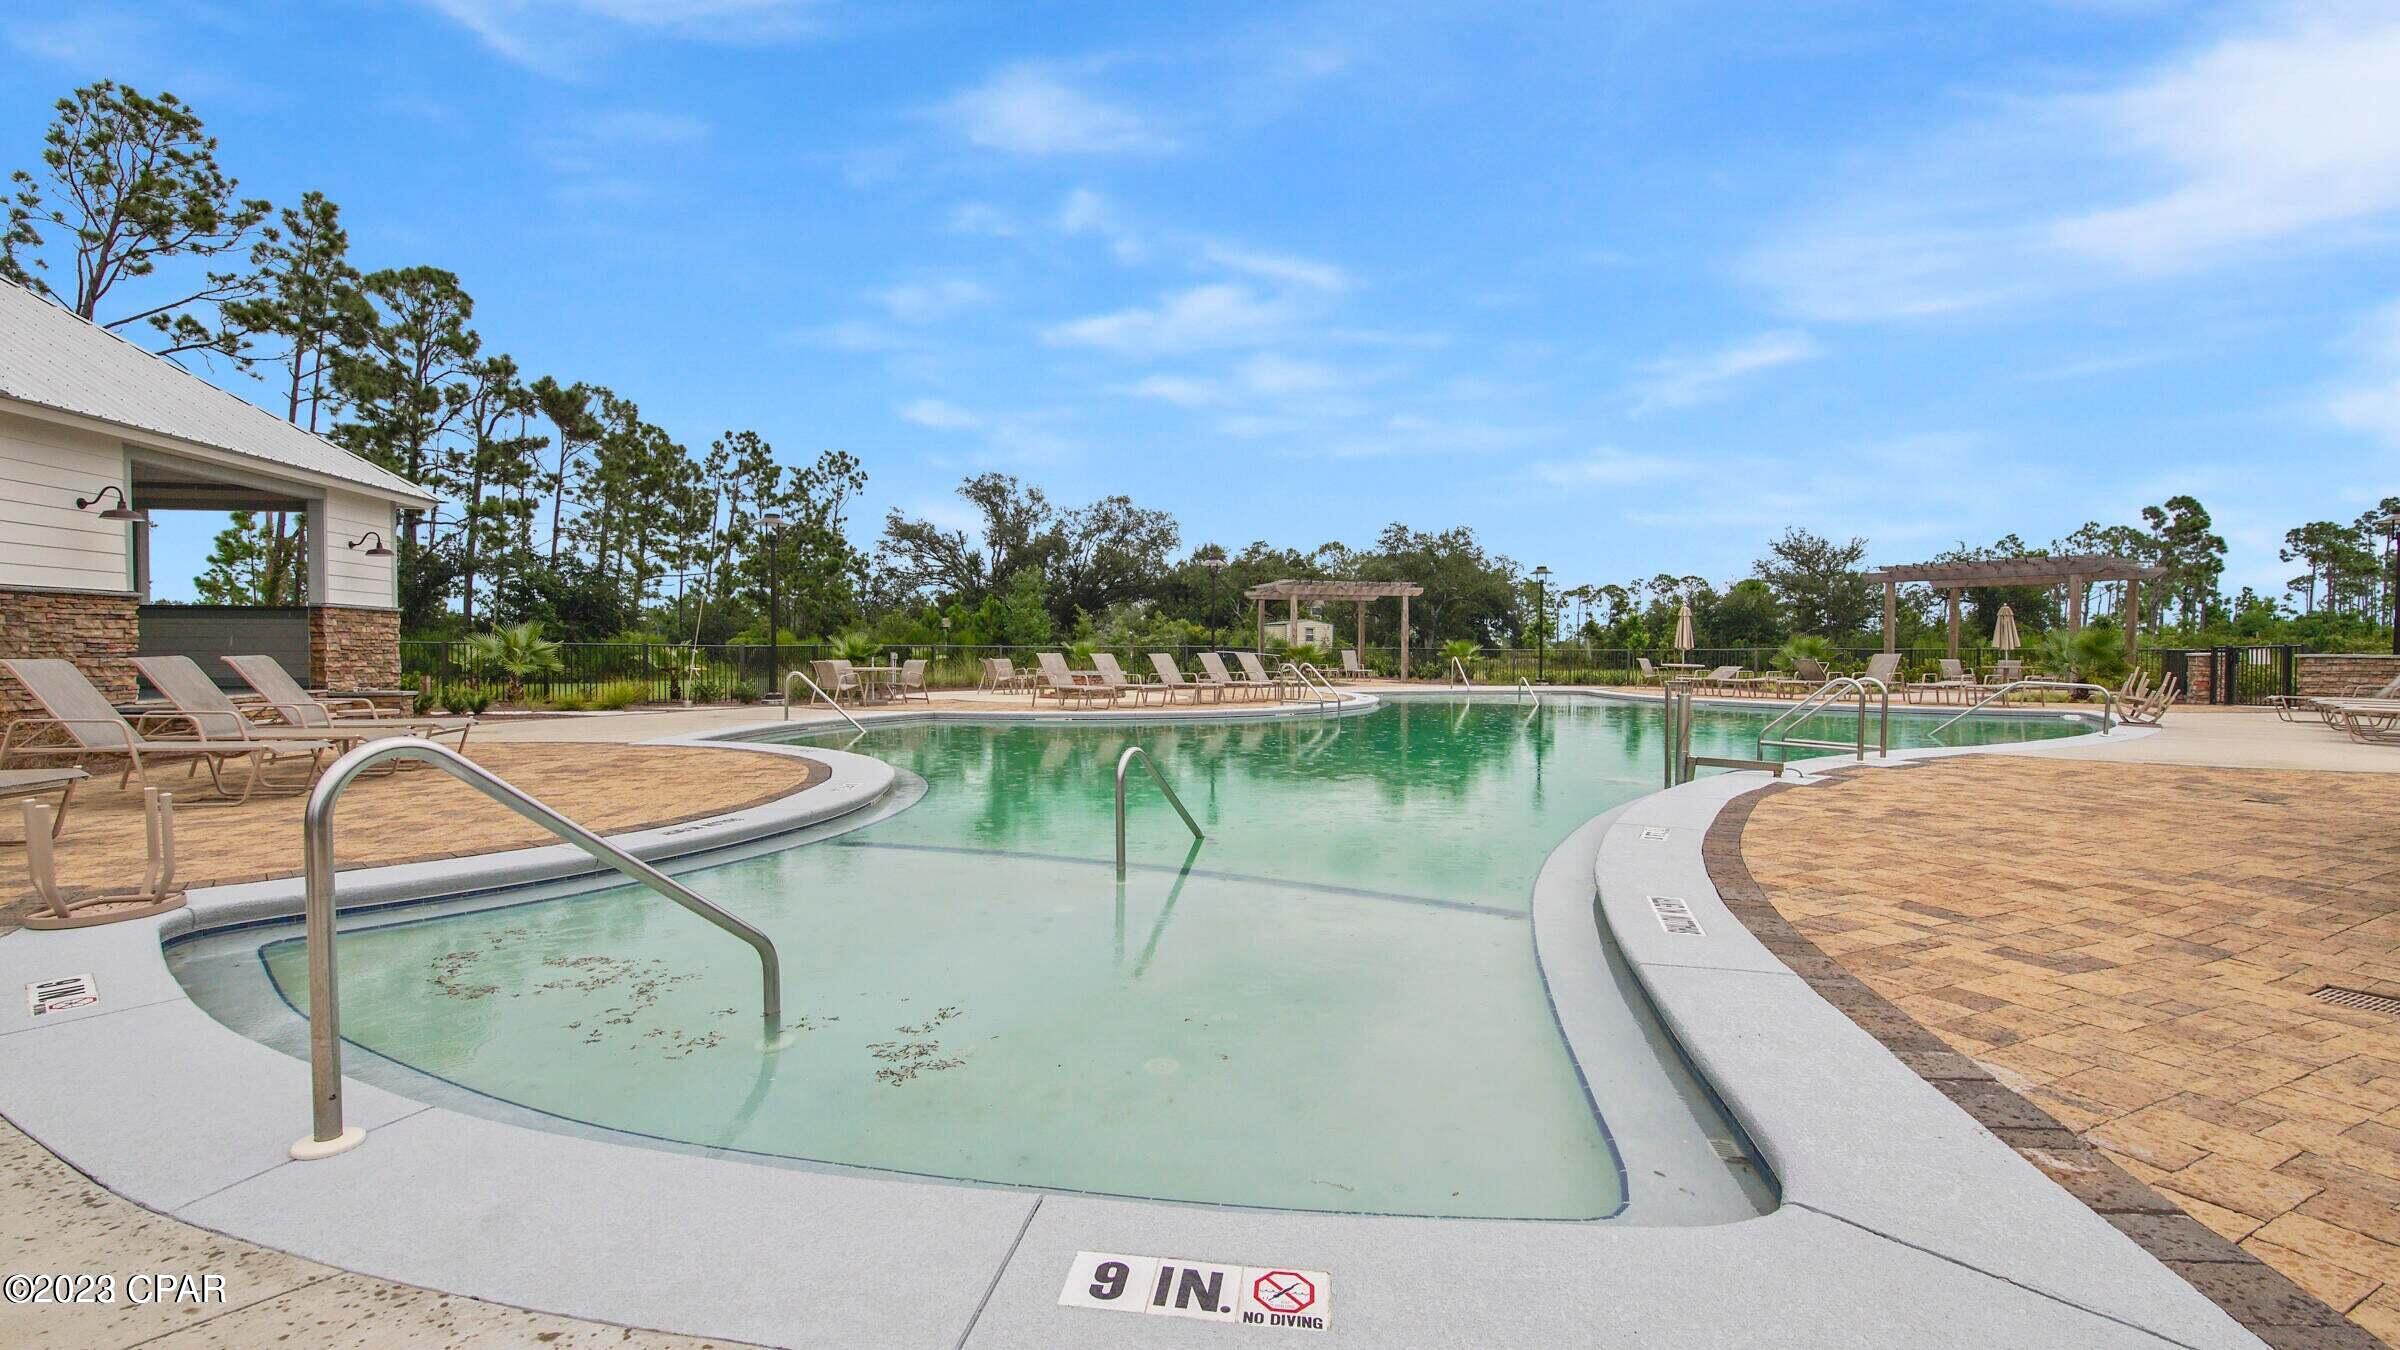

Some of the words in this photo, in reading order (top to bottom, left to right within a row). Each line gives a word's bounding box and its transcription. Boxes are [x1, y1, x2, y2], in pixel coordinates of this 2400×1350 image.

[1088, 1261, 1130, 1301] 9
[1152, 1266, 1232, 1314] IN.
[1242, 1311, 1264, 1325] NO
[1269, 1313, 1324, 1330] DIVING
